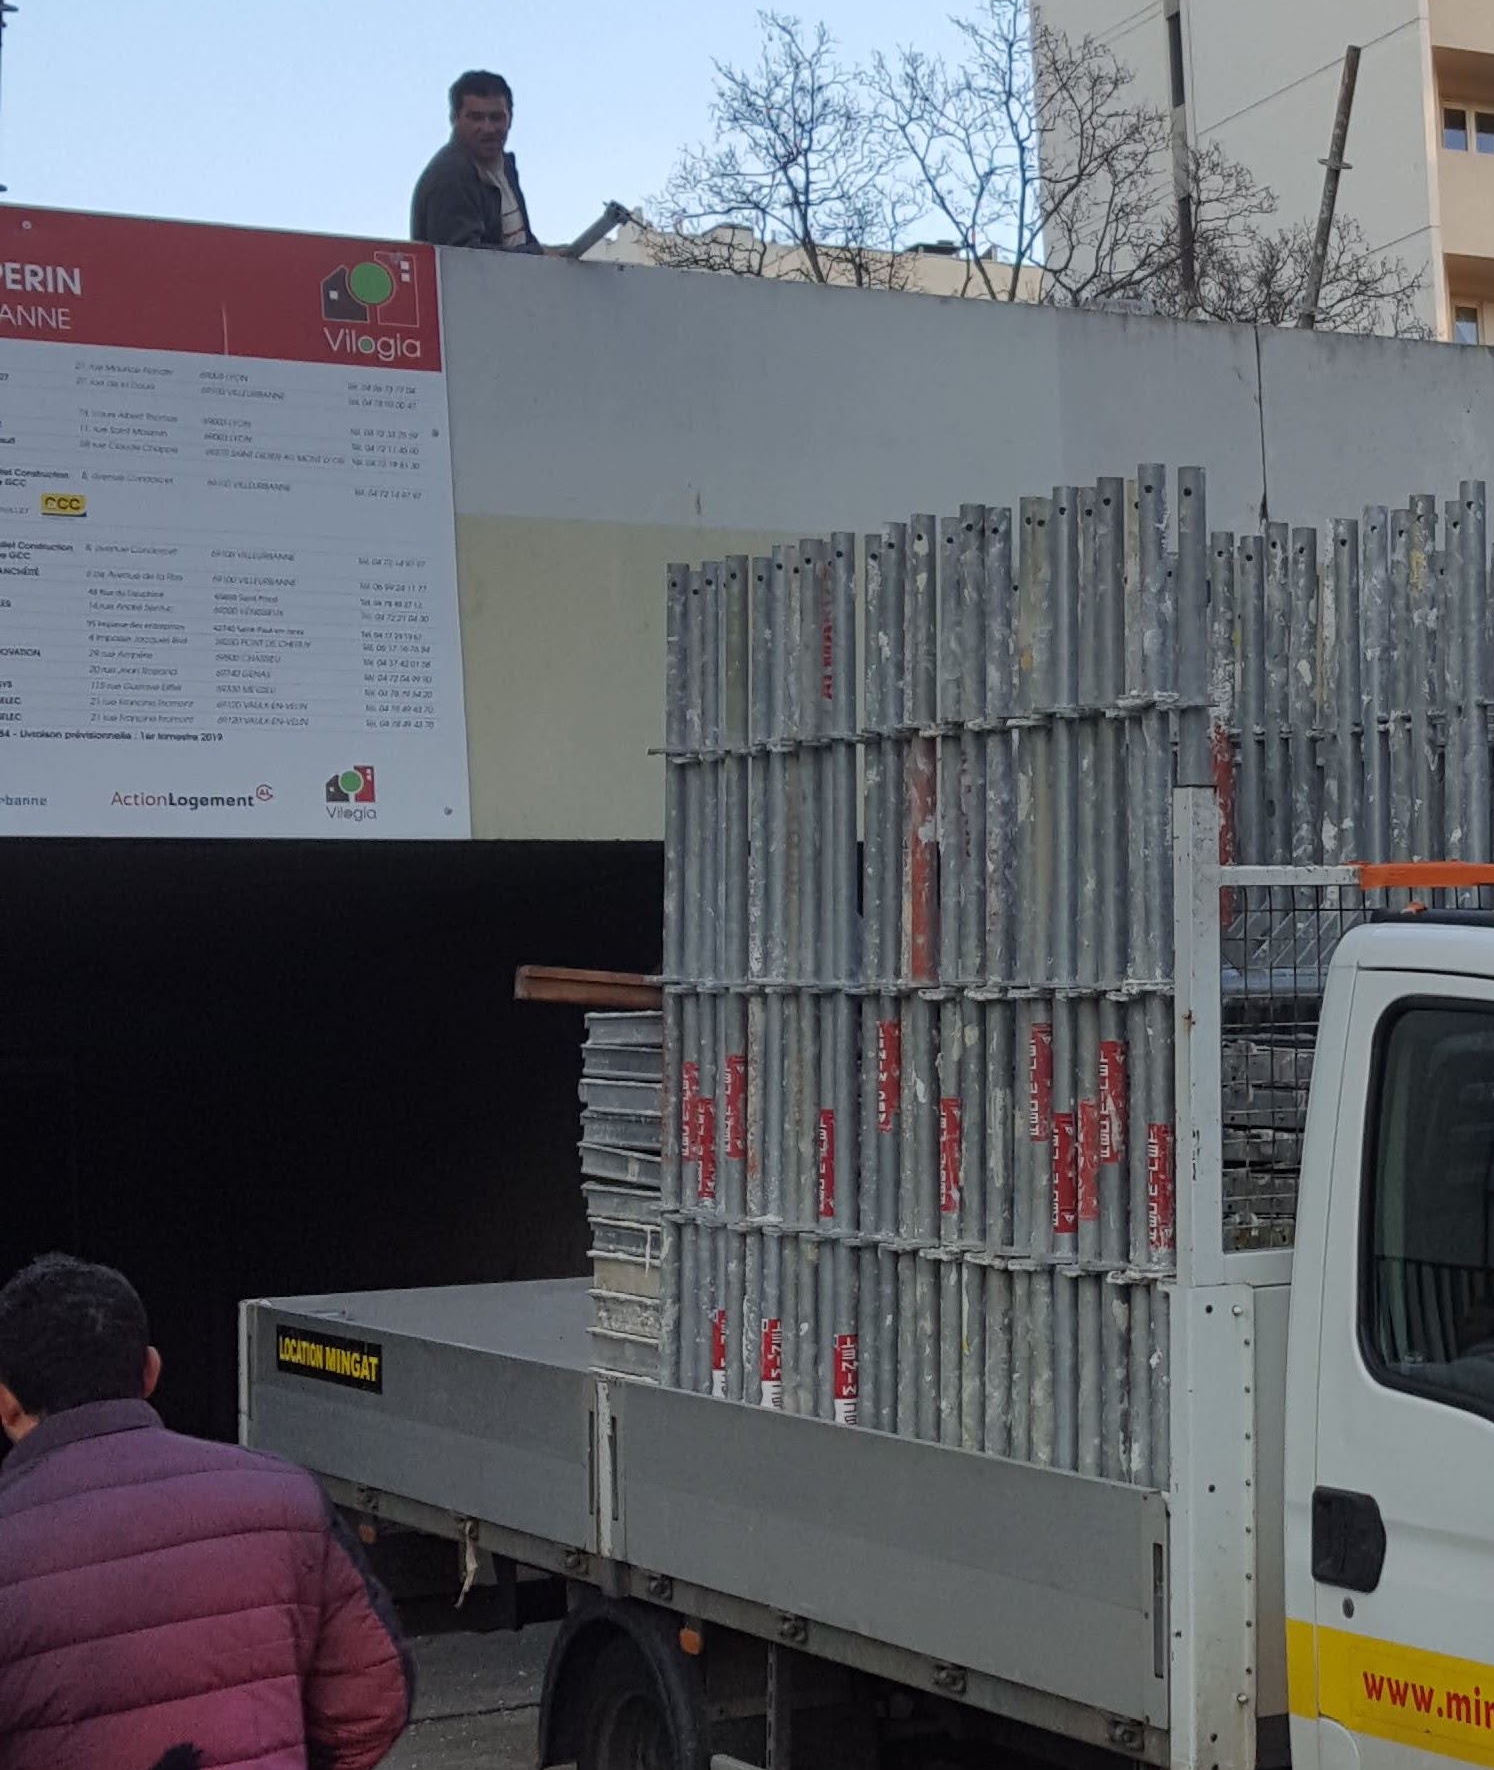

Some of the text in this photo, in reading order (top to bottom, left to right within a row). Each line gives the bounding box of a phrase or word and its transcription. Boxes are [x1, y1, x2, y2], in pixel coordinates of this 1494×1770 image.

[0, 260, 81, 295] ERIN
[323, 327, 421, 361] Vilogia
[20, 730, 62, 740] Livraison
[65, 730, 131, 742] prévisionnelle
[158, 731, 199, 741] trimestre
[201, 732, 224, 742] 2019
[110, 790, 254, 810] ActionLogement
[325, 806, 377, 821] Vilogia
[278, 1335, 379, 1382] LOCATION MINGAT
